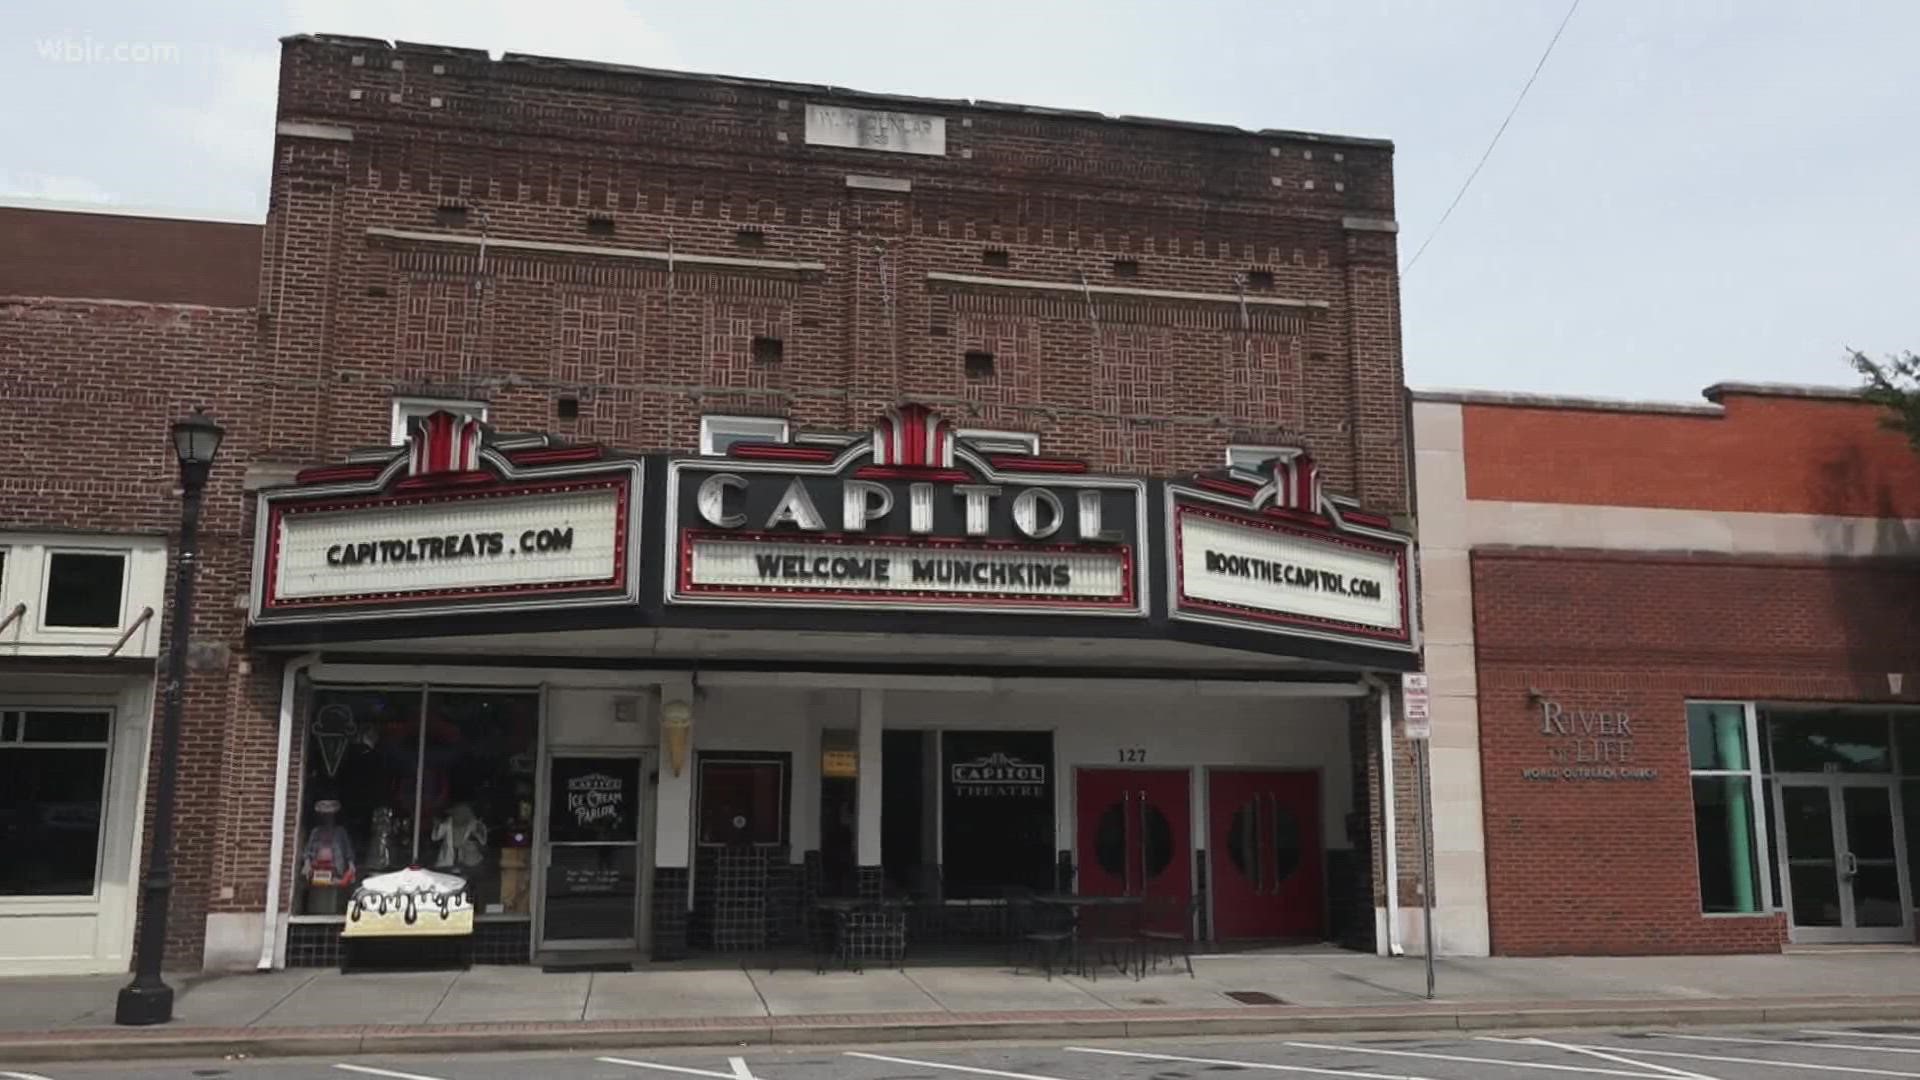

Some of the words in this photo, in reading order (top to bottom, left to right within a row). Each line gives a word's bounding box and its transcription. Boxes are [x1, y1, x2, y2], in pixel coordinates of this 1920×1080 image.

[697, 473, 1125, 541] CAPITOL
[755, 553, 890, 581] WELCOME
[912, 560, 1071, 587] MUNCHKINS
[1540, 700, 1633, 736] RIVER
[1118, 748, 1147, 763] 127
[1574, 739, 1633, 763] LIFE
[955, 767, 1041, 780] CAPITOL
[955, 785, 1044, 797] THEATRE
[574, 804, 618, 827] PARLOR
